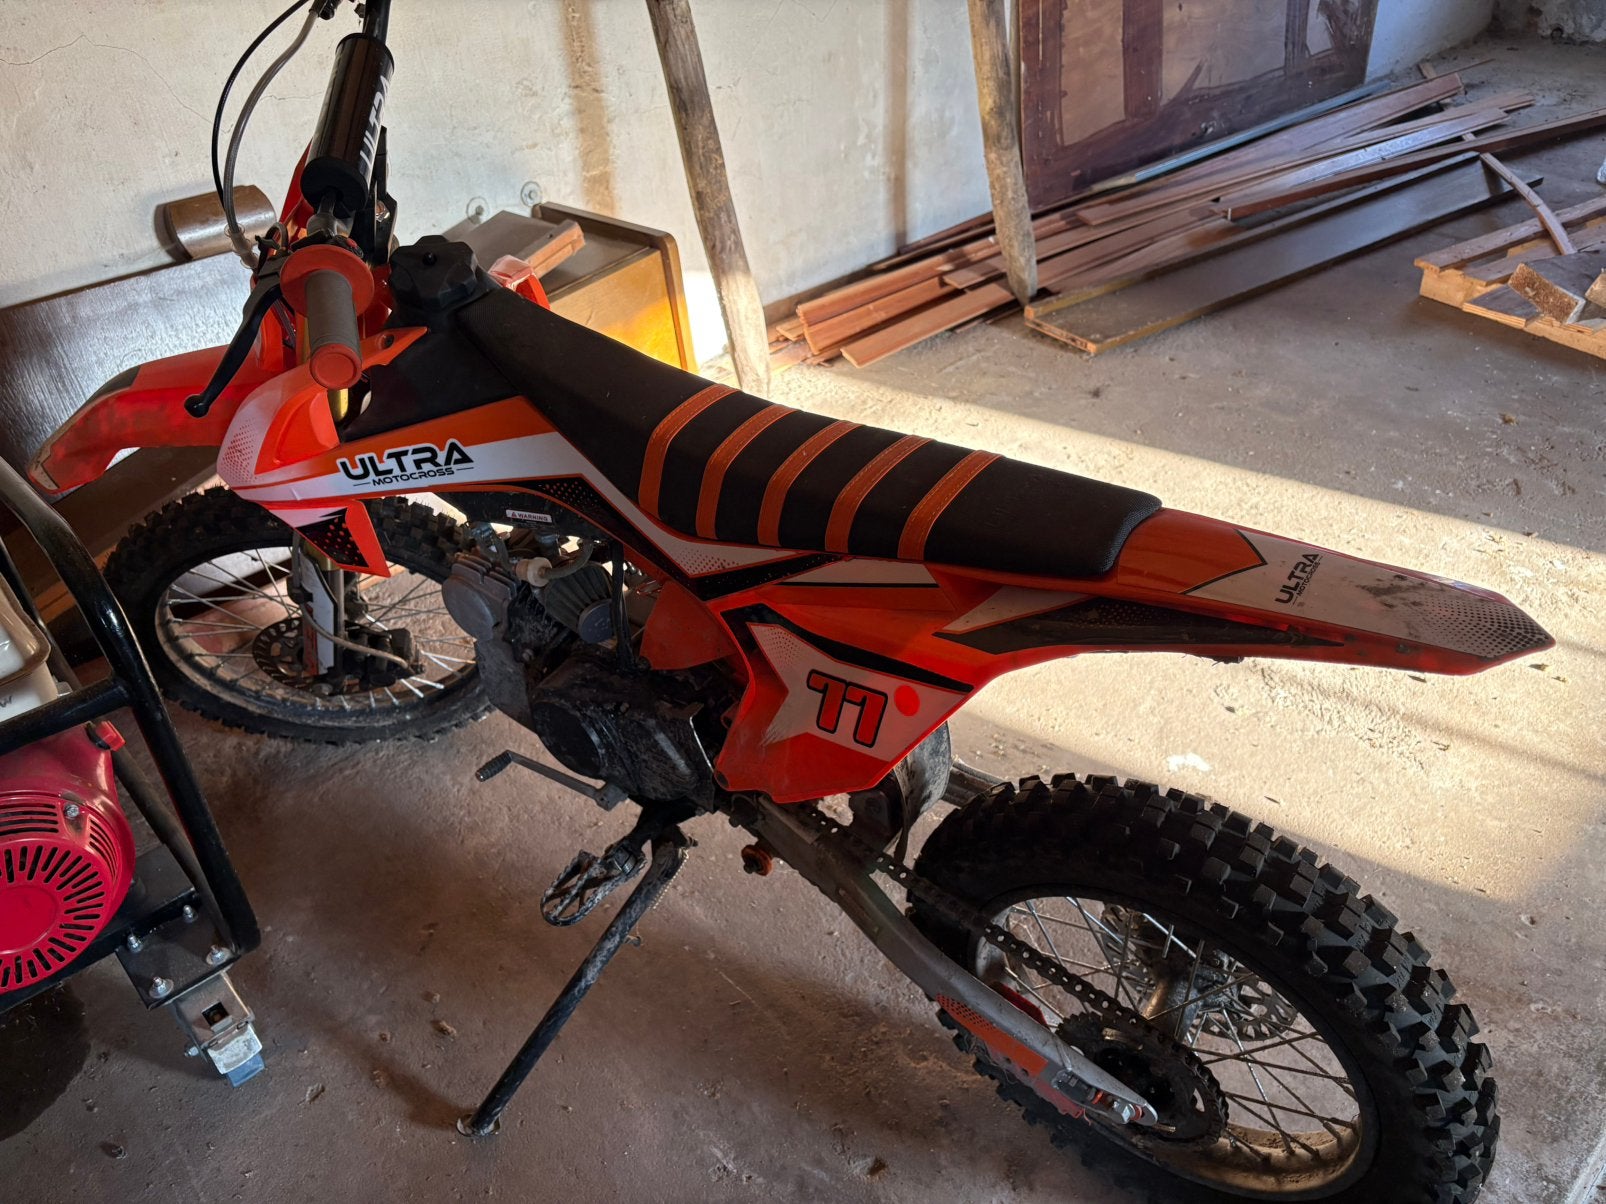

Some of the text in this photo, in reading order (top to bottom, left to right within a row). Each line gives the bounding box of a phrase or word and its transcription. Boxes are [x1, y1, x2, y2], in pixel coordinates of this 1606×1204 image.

[338, 440, 475, 481] ULTRA
[372, 467, 455, 487] MOTOCROSS
[517, 512, 548, 521] WARNING
[1274, 553, 1320, 604] ULTRA
[806, 668, 889, 749] 77
